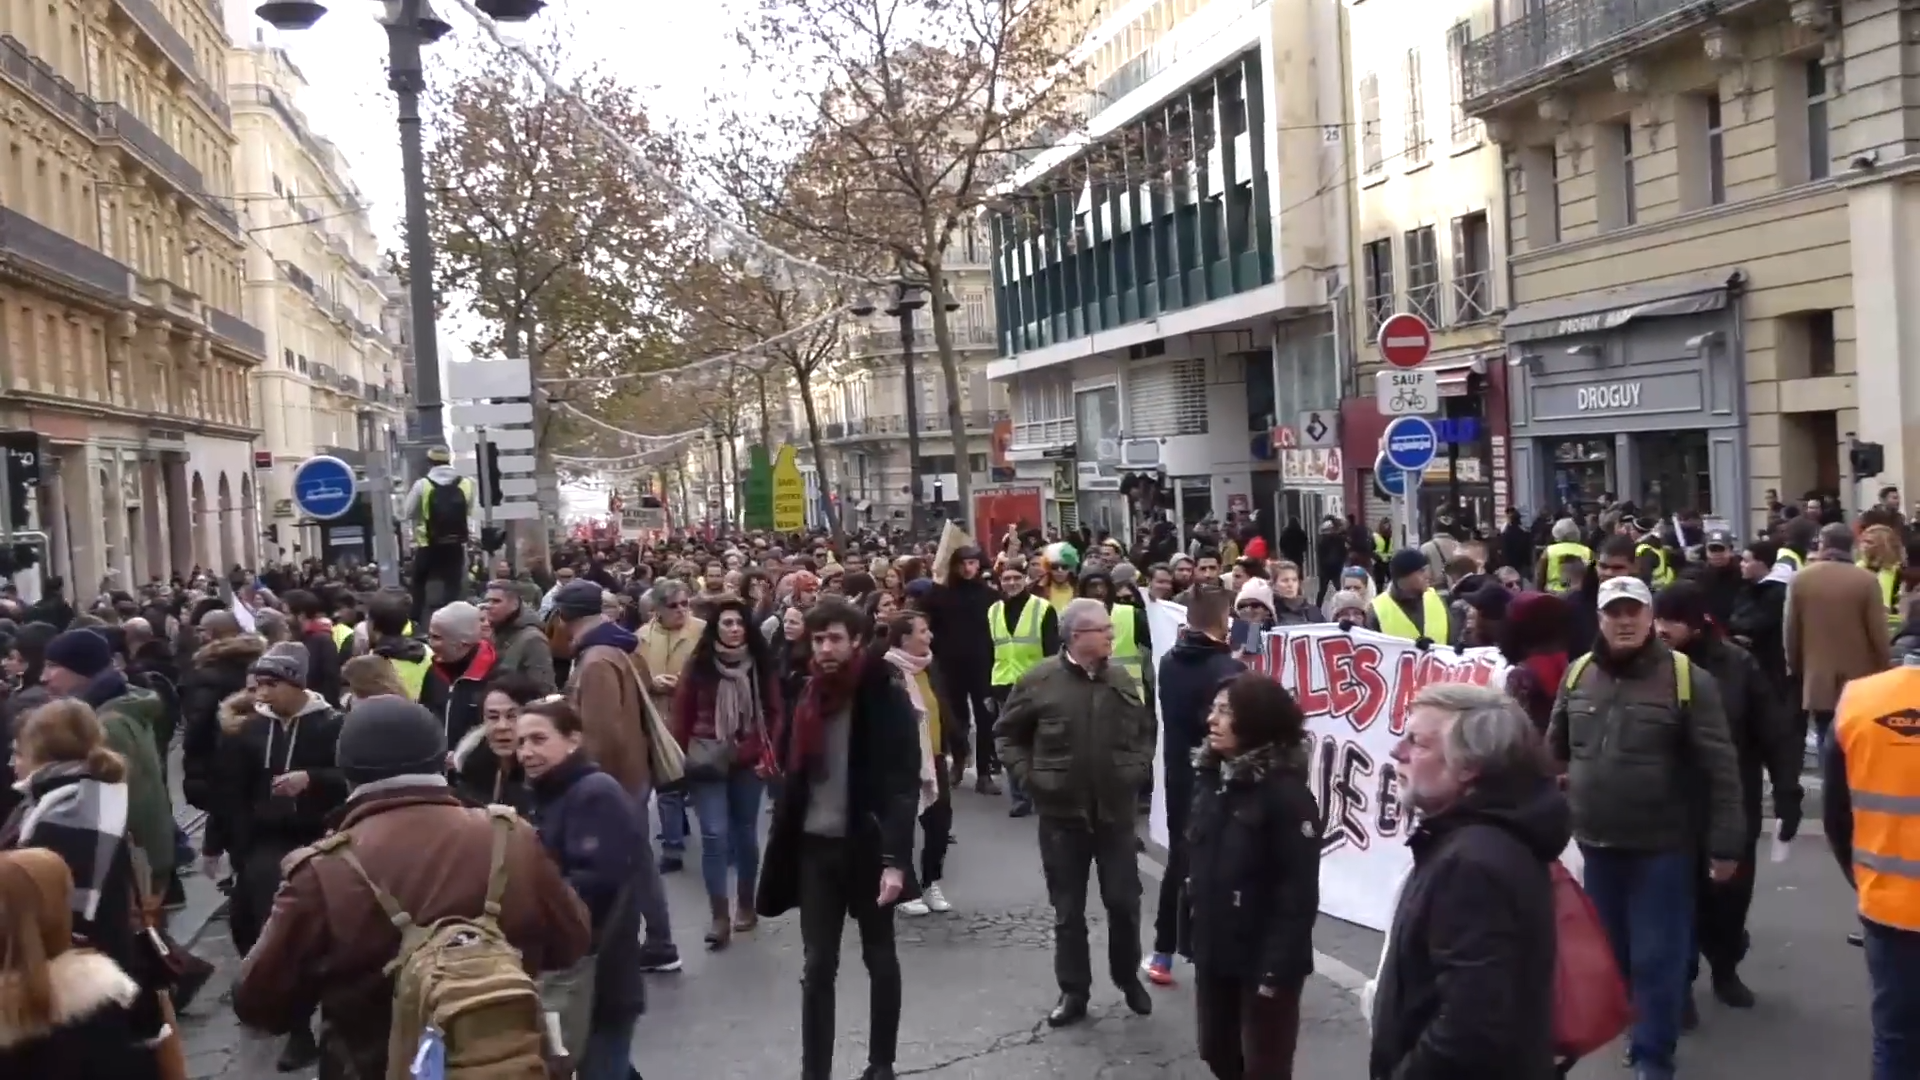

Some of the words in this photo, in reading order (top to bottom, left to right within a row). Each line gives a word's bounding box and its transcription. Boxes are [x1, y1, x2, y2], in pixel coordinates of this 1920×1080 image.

[1325, 130, 1340, 142] 25
[1392, 374, 1424, 386] SAUF
[1577, 382, 1642, 411] DROGUY
